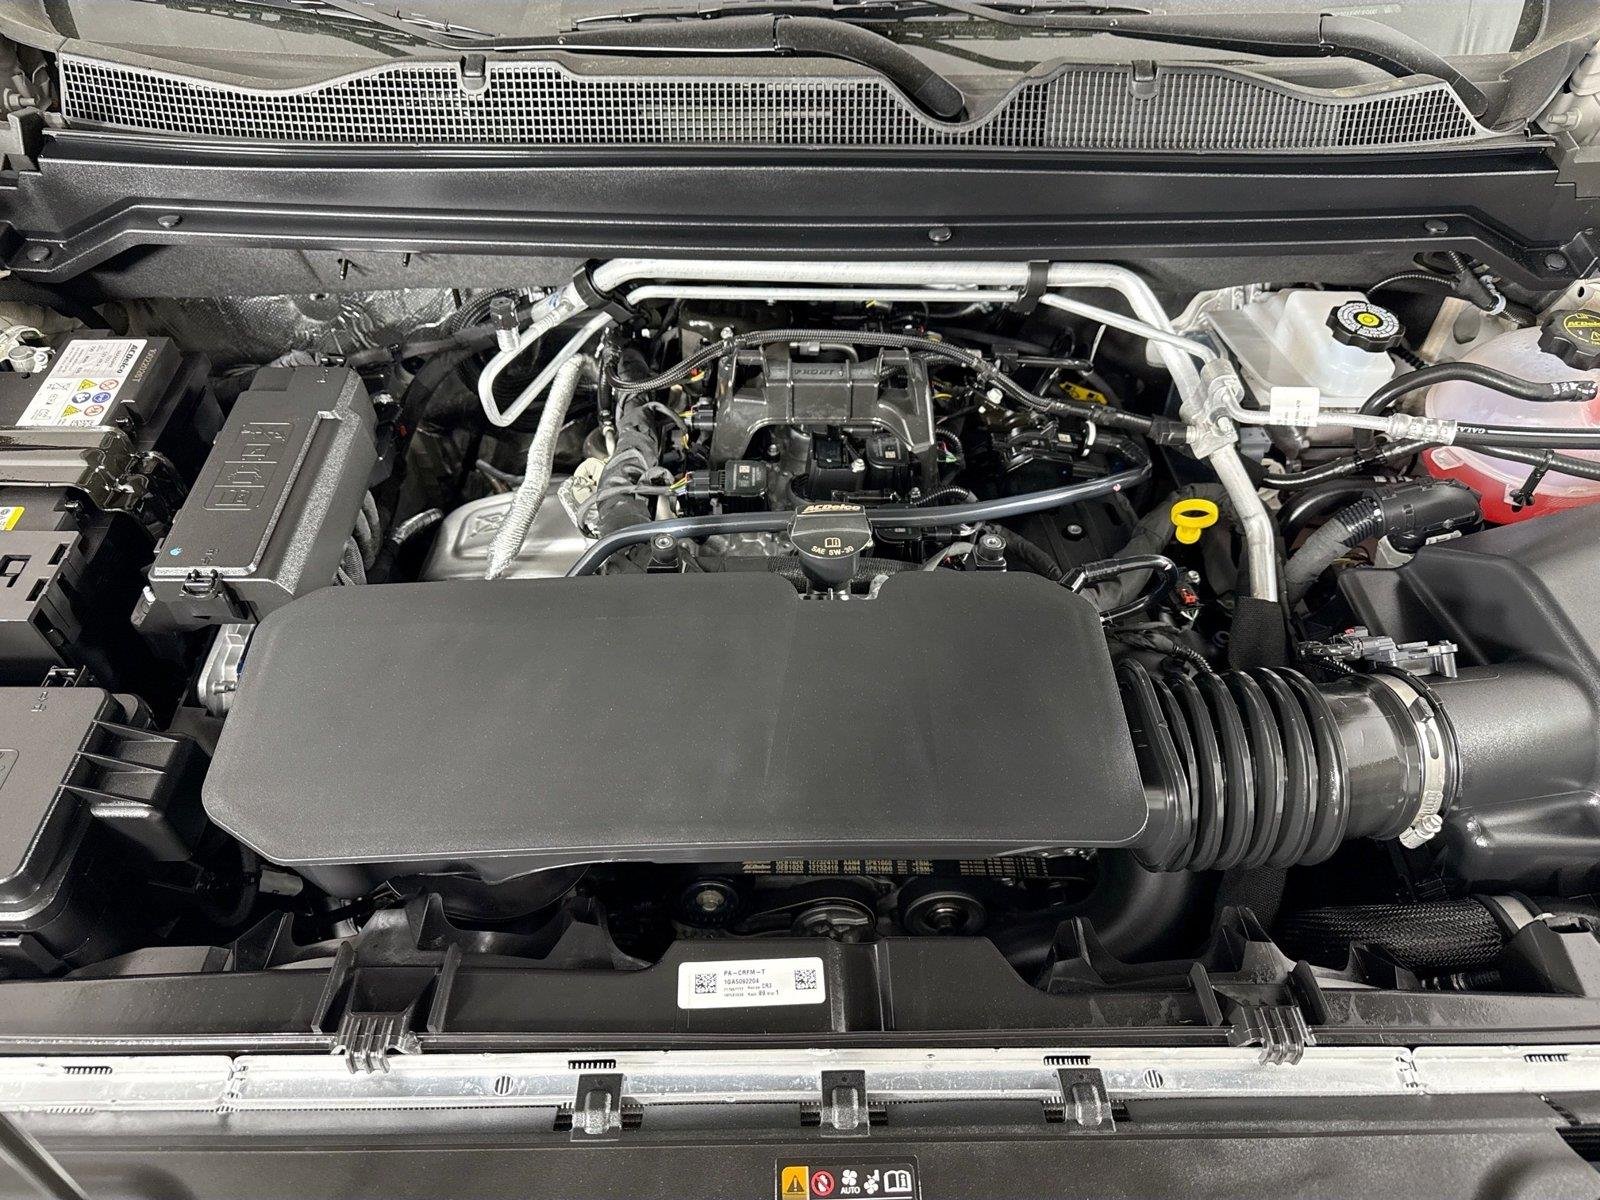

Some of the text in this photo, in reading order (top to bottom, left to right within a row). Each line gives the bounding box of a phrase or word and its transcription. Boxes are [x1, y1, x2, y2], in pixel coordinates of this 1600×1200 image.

[116, 344, 139, 374] ACDelco
[1456, 425, 1486, 434] GALA
[801, 503, 861, 514] ACDelco
[811, 545, 855, 556] SAE 5W-30
[840, 1186, 861, 1194] AUTO
